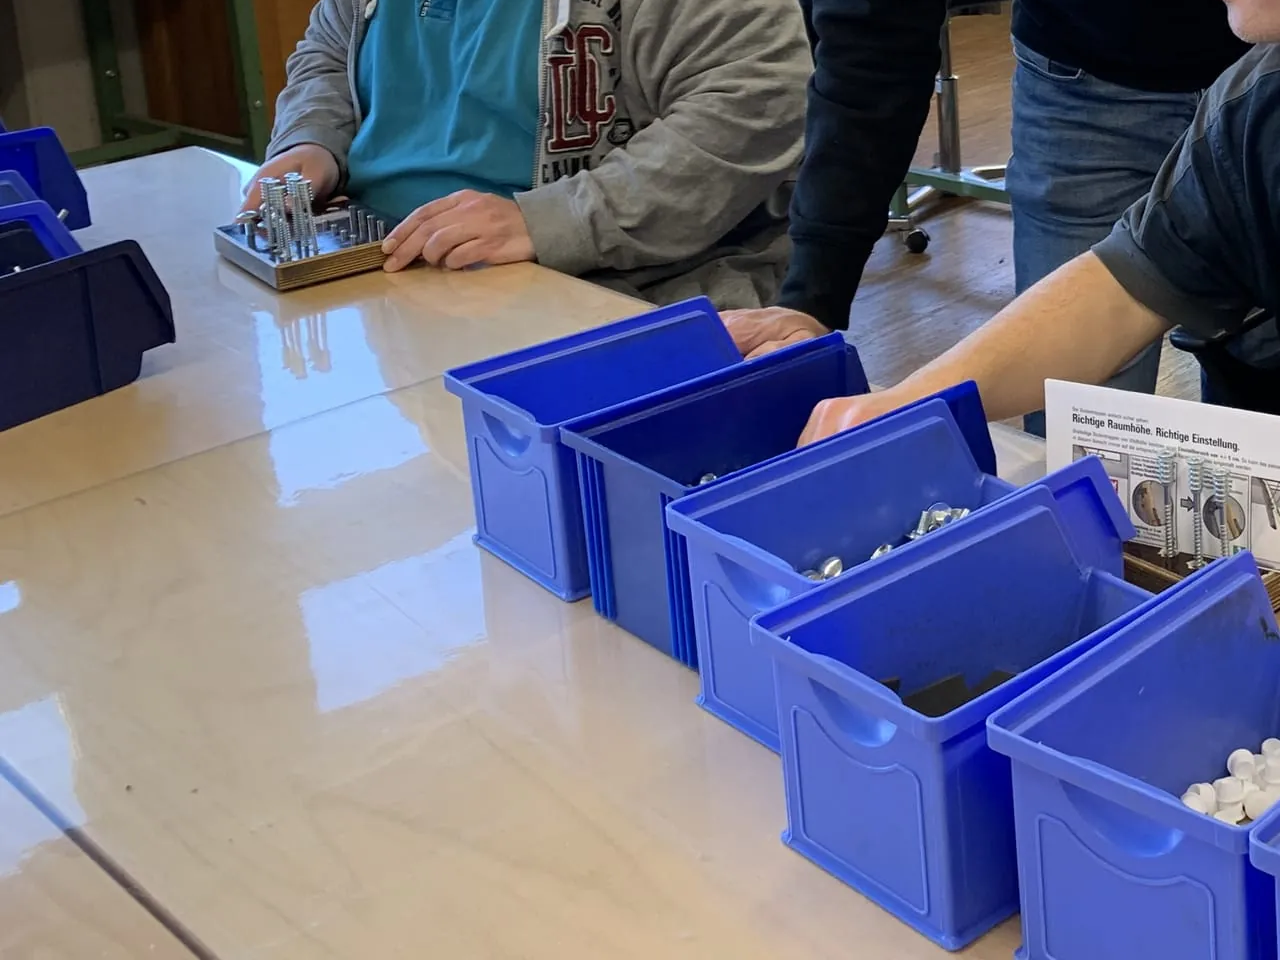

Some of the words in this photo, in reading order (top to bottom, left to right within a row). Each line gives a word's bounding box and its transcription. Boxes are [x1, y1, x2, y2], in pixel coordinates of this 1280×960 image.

[1072, 413, 1105, 428] Richtige
[1107, 419, 1153, 436] Raumhöhe.
[1156, 427, 1190, 442] Richtige
[1192, 433, 1240, 452] Einstellung.
